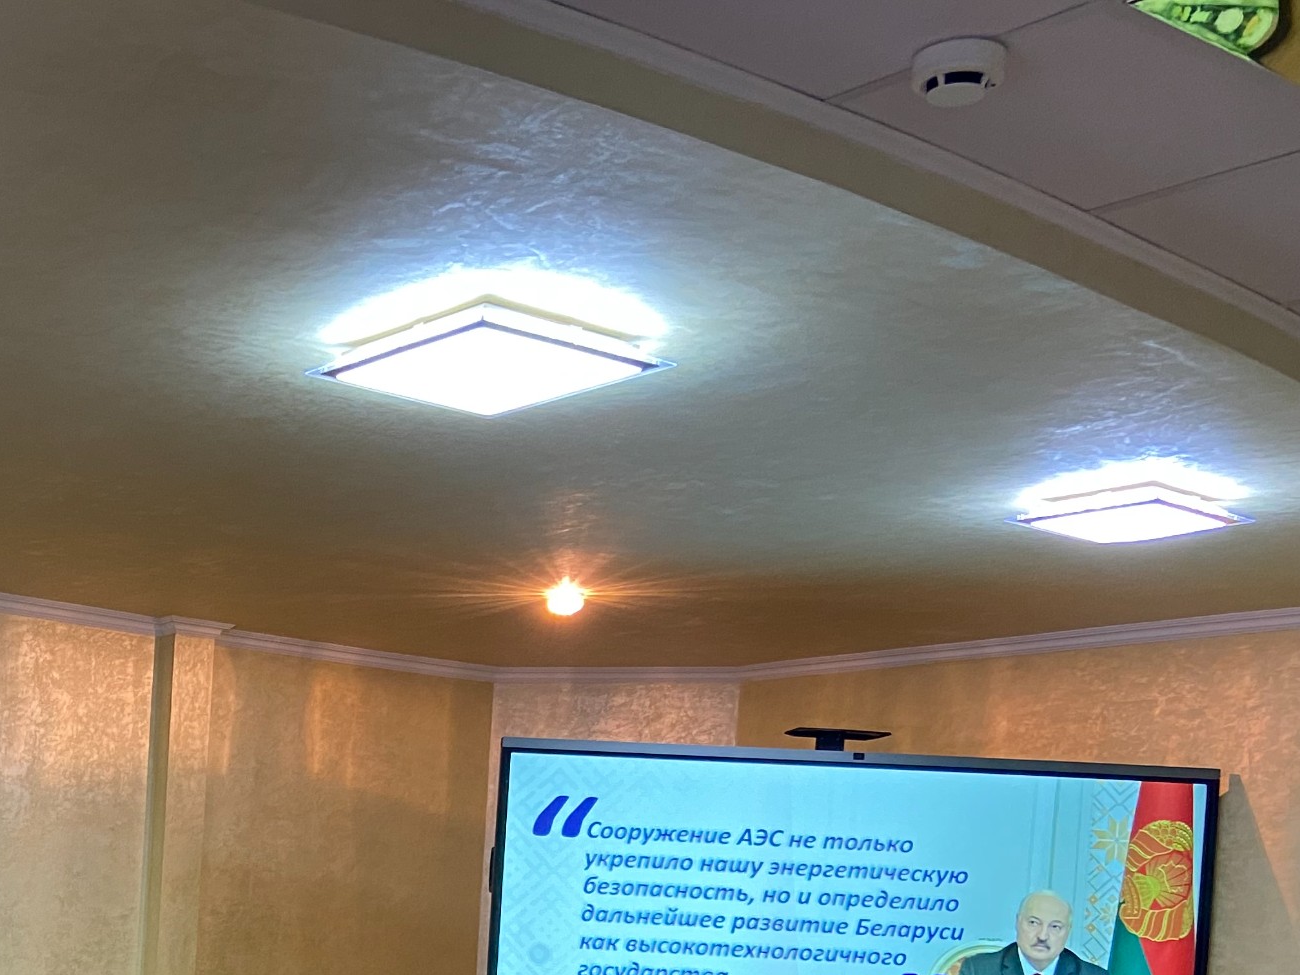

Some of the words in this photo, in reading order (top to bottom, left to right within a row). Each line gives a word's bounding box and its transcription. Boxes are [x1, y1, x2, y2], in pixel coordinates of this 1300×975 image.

[587, 821, 731, 845] Сооружение
[737, 828, 784, 847] АЭС
[789, 835, 816, 848] не
[823, 836, 913, 853] только
[584, 853, 693, 871] укрепило
[700, 858, 764, 878] нашу
[768, 862, 968, 887] энергетическую
[583, 877, 754, 905] безопасность,
[763, 890, 790, 903] но
[798, 892, 811, 904] и
[818, 890, 959, 912] определило
[581, 904, 725, 929] дальнейшее
[731, 916, 848, 934] развитие
[855, 919, 964, 943] Беларуси
[579, 937, 619, 951] как
[625, 938, 906, 966] высокотехнологичного
